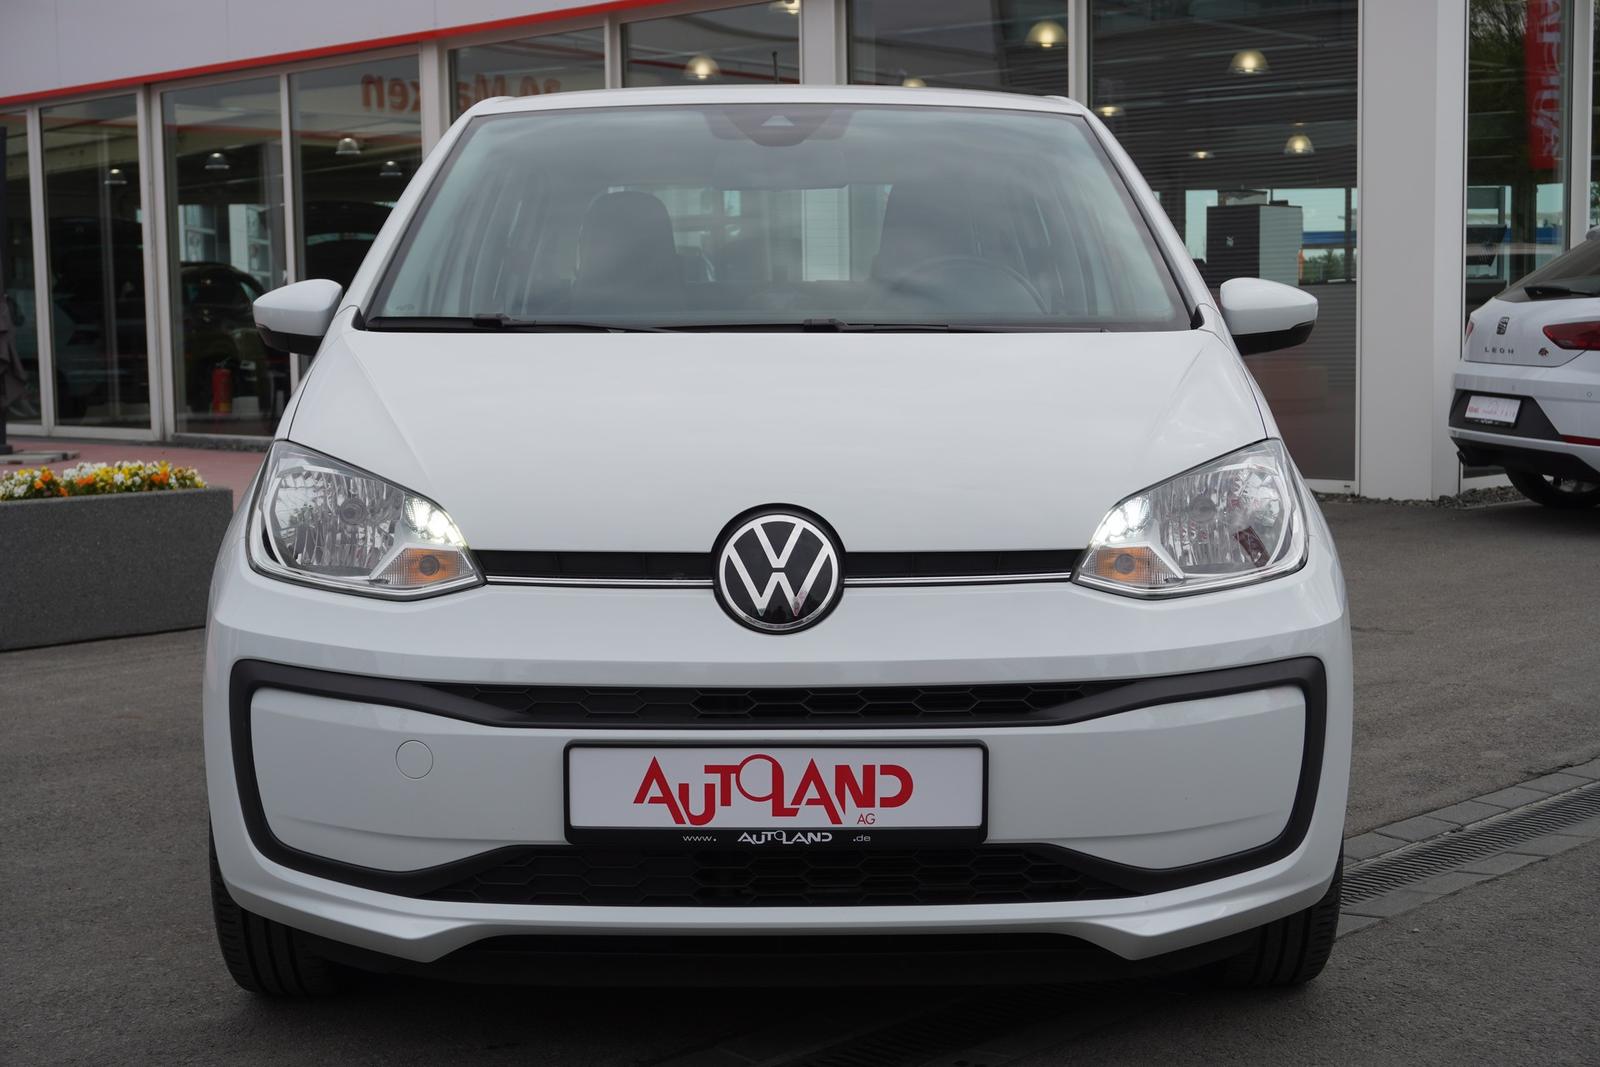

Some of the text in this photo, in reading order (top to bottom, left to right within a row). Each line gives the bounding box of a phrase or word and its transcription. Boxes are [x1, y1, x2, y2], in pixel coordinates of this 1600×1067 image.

[633, 754, 914, 826] AUTOLAND
[857, 812, 876, 825] AG
[683, 830, 871, 845] www. AUTOLAND .de
